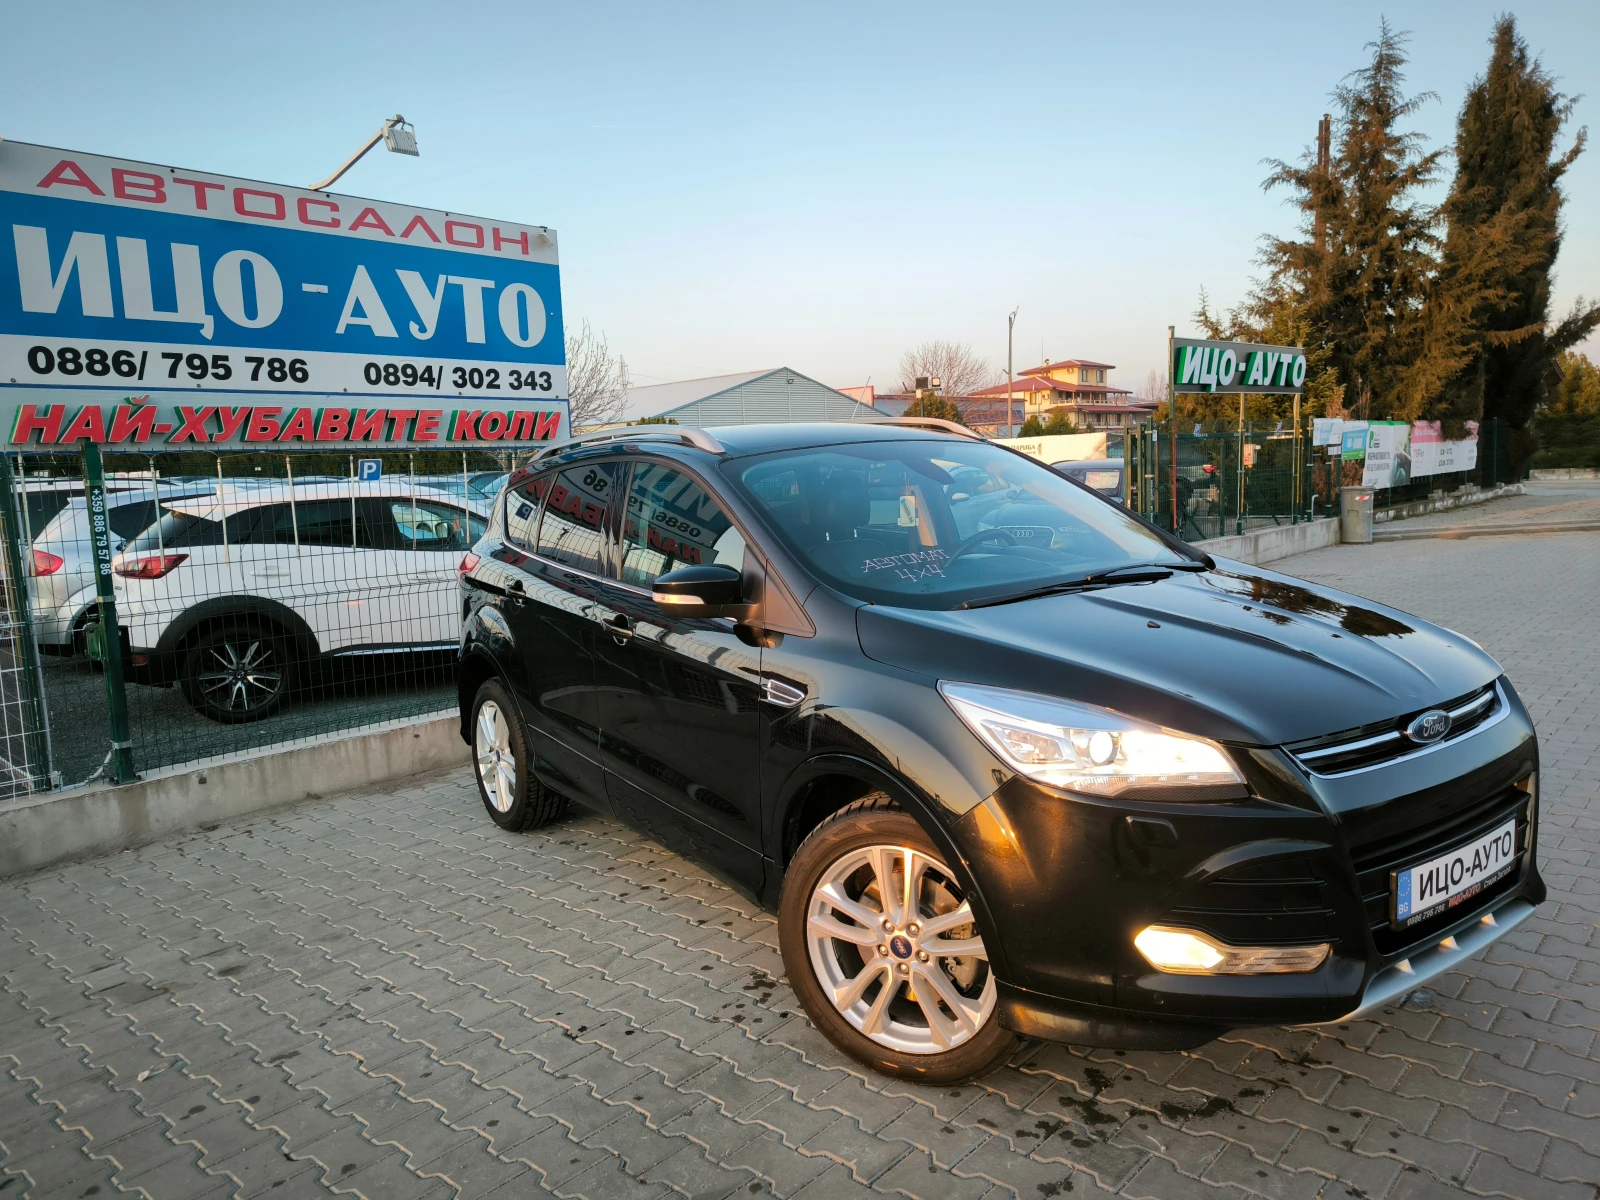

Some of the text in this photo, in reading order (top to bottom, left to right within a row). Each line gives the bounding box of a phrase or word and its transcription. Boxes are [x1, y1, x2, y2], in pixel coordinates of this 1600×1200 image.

[36, 159, 529, 255] АВТОСАЛОН
[27, 345, 309, 383] 0886/ 795 786
[363, 362, 553, 391] 0894/ 302 343
[1181, 345, 1307, 392] ИЦО-АУТО
[10, 394, 562, 444] НАЙ-ХУБАВИТЕ КОЛИ
[92, 488, 111, 575] +359 886 79 57 86
[860, 548, 951, 573] АВТОМАТ
[1423, 714, 1446, 737] Ford
[1419, 830, 1512, 902] ИЦО-АУТО
[1398, 902, 1409, 915] BG
